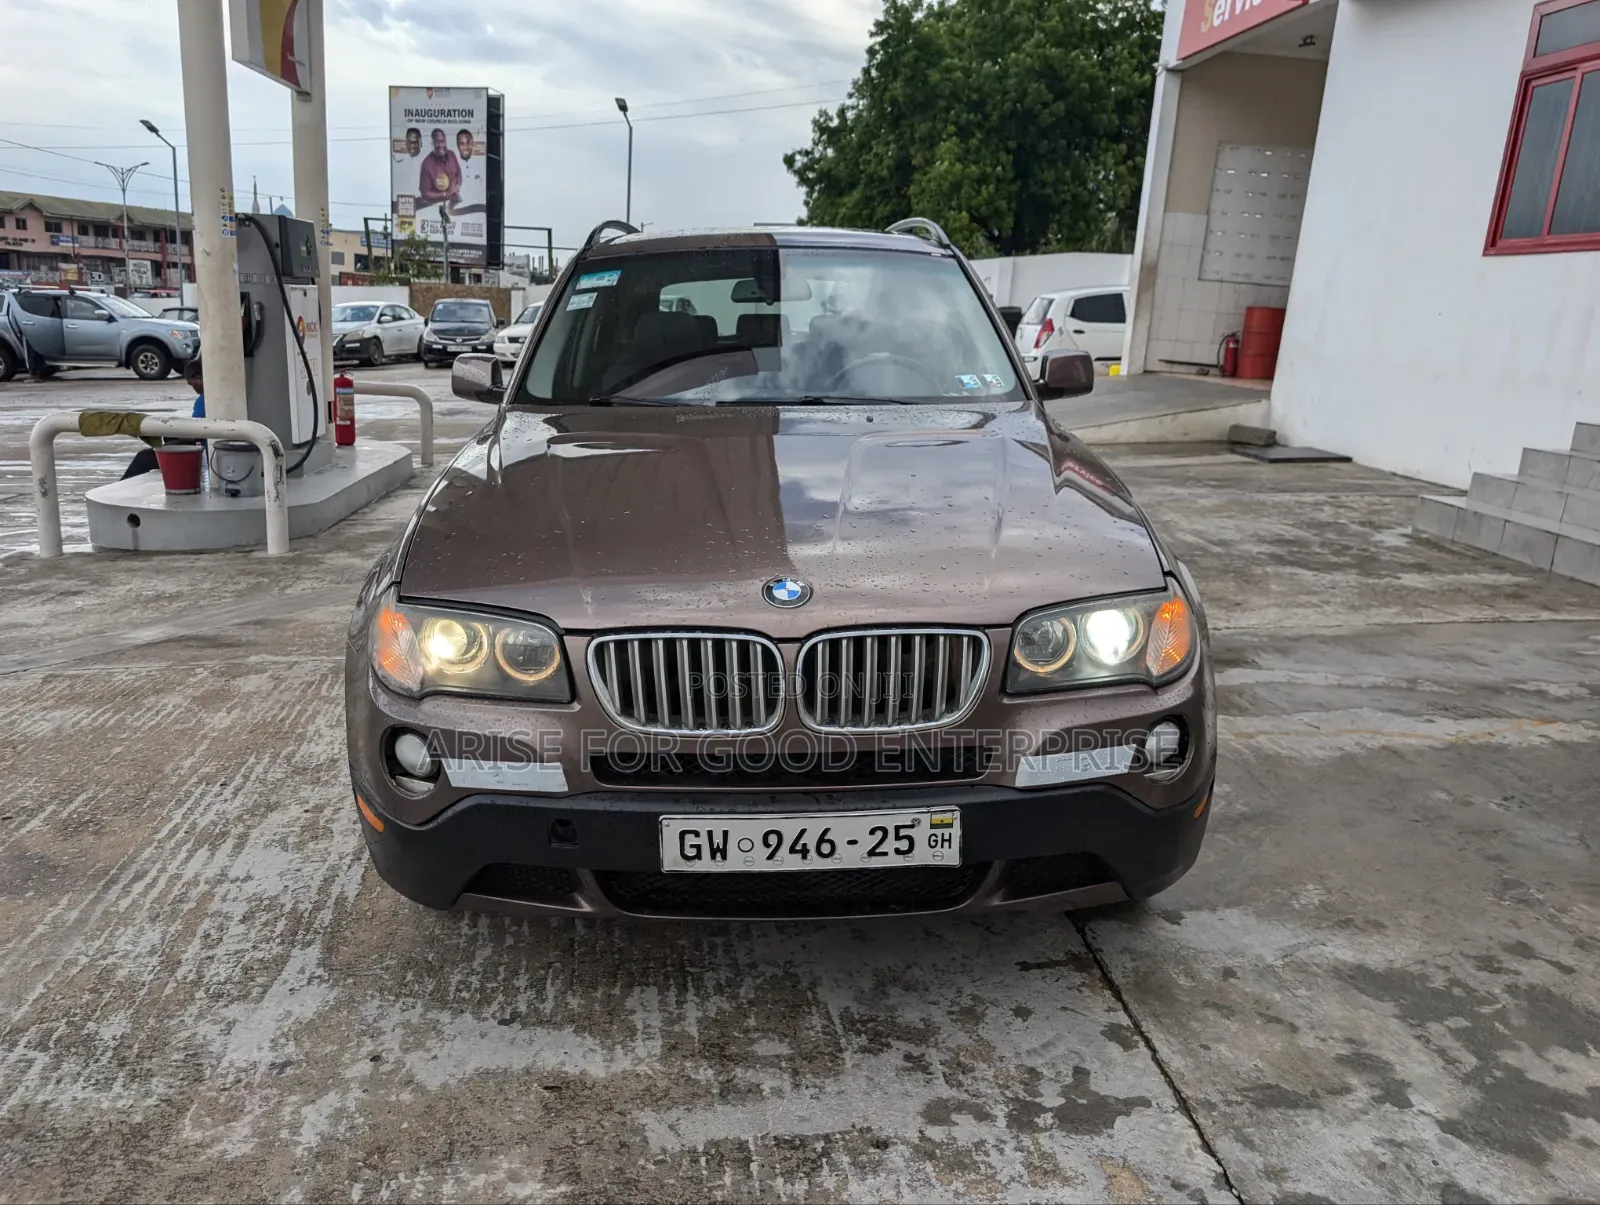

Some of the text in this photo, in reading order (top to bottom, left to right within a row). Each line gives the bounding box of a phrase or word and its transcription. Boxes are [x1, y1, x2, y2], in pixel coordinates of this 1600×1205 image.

[404, 108, 474, 119] INAUGURATION
[678, 829, 729, 861] GW
[928, 832, 952, 850] GH
